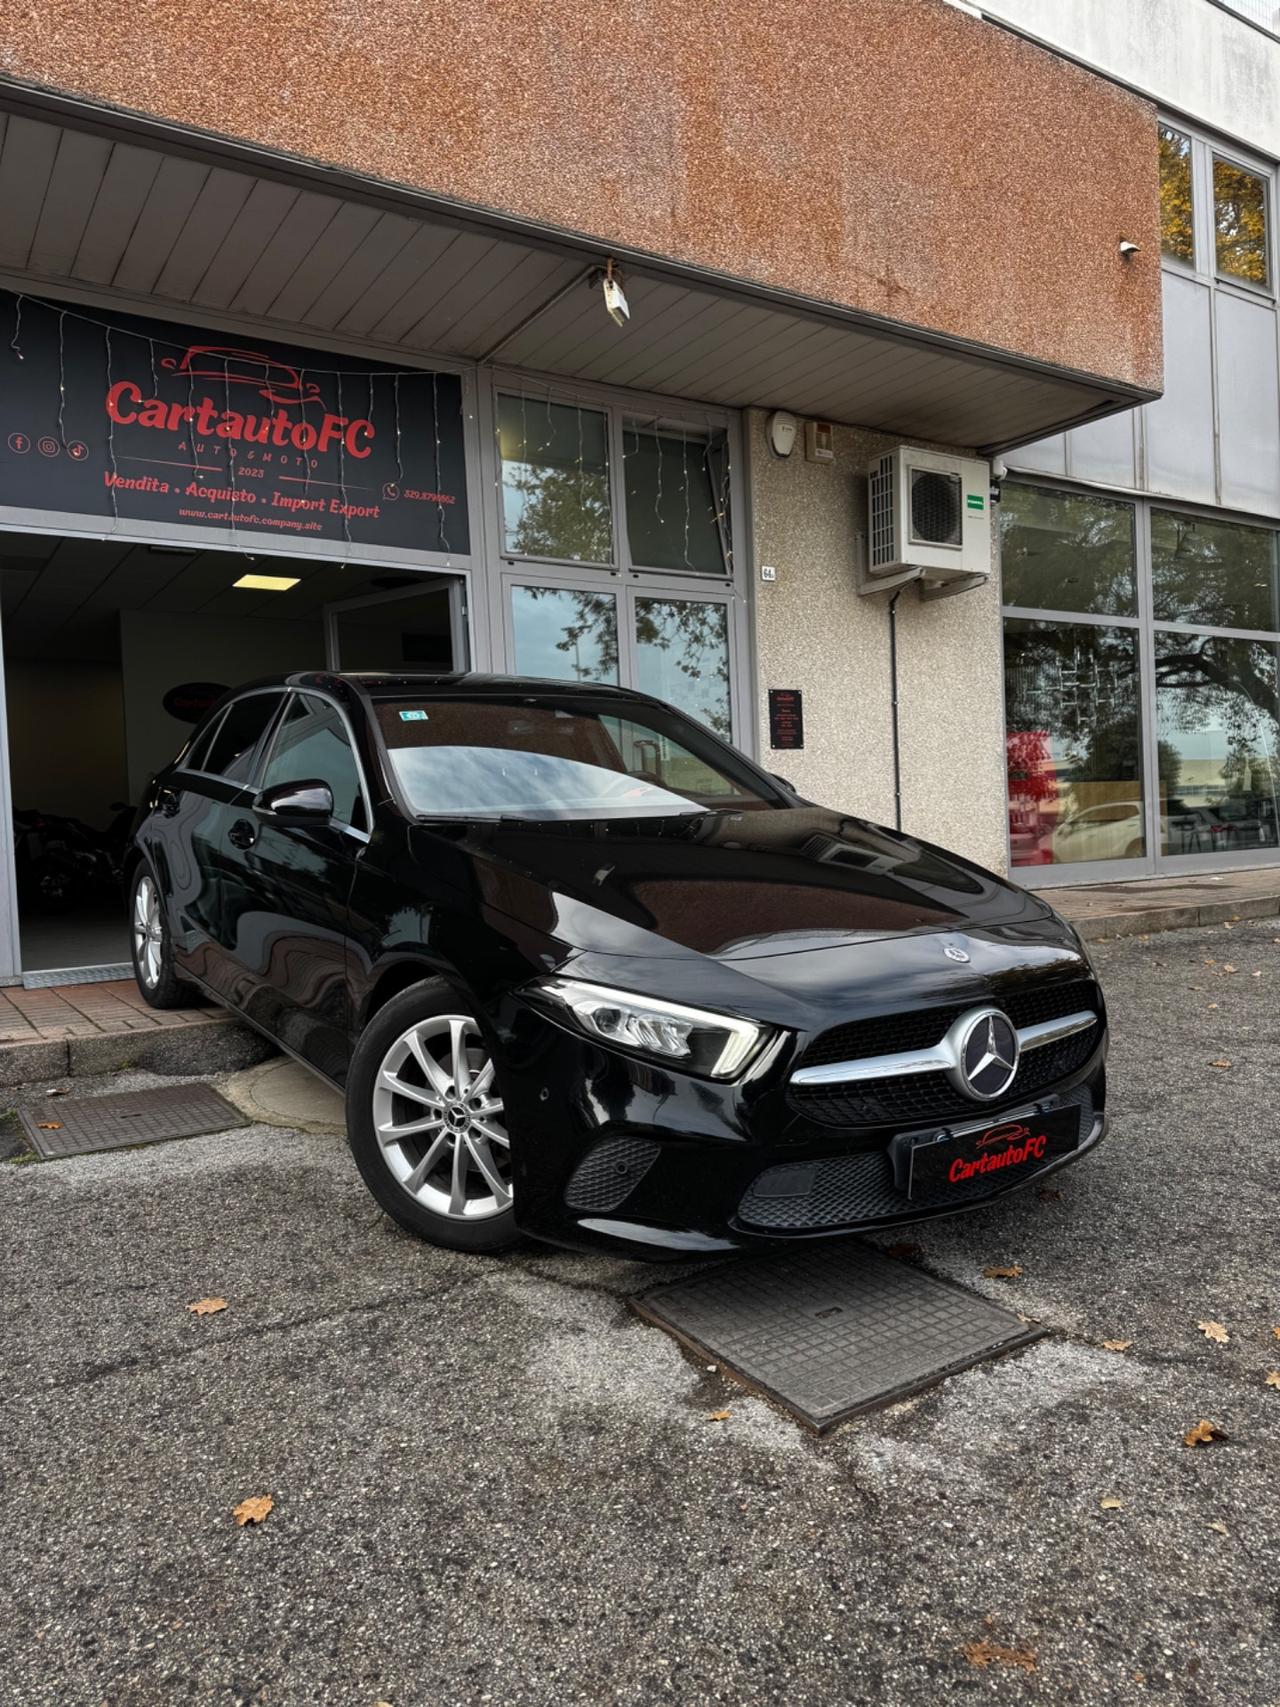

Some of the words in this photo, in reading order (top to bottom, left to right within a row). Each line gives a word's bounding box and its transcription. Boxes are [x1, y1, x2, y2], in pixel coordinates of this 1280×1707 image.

[105, 380, 376, 459] CartautoFC
[103, 471, 169, 494] Vendita
[185, 481, 256, 504] Acquisto
[272, 491, 327, 512] Import
[329, 499, 381, 519] Export
[948, 1134, 1047, 1184] CartautoFC
